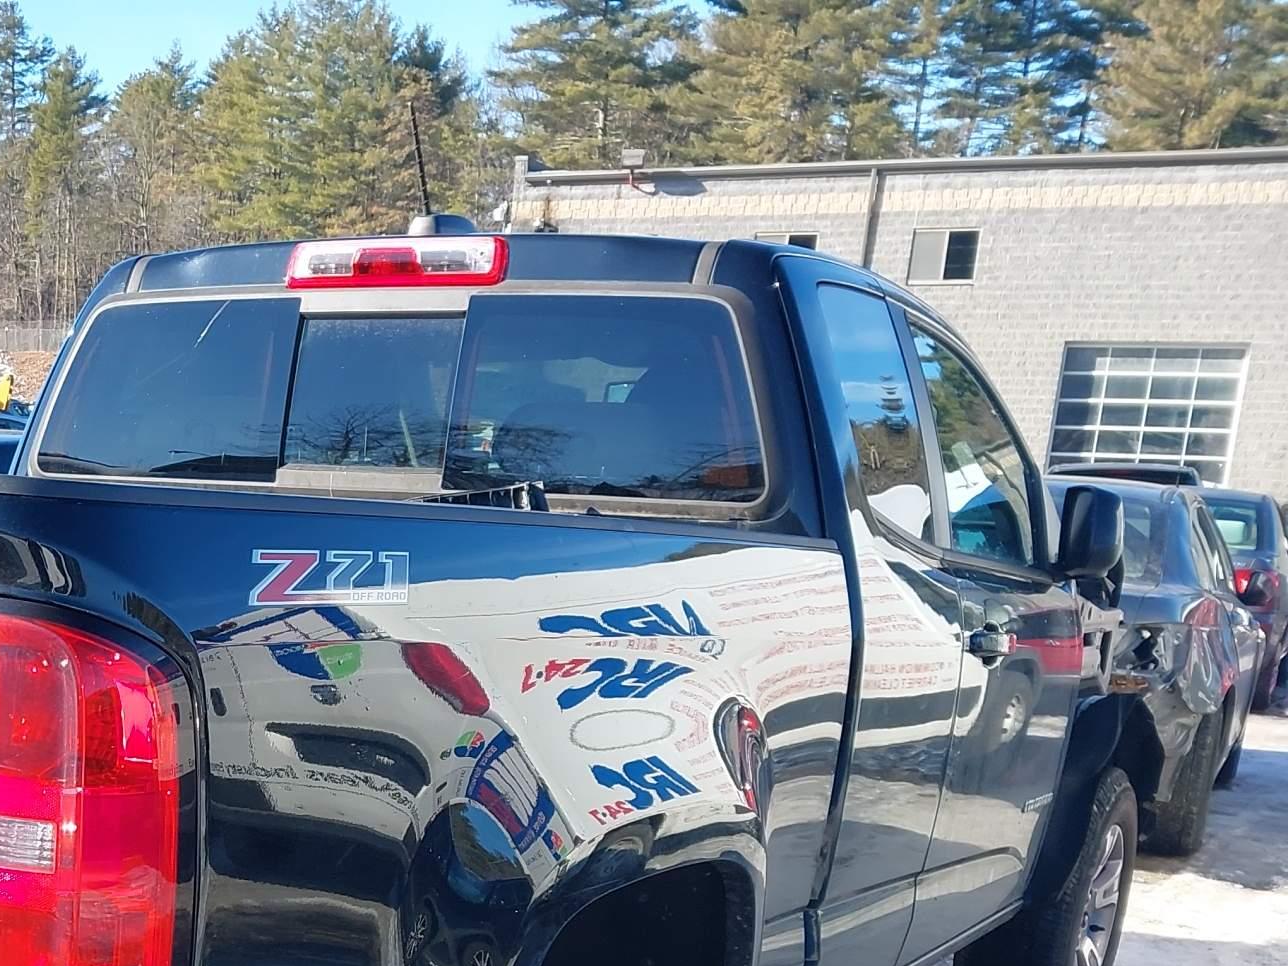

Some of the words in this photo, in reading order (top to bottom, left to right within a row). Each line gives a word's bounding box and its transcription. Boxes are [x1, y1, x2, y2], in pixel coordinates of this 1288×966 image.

[248, 549, 409, 606] Z71
[352, 591, 374, 600] OFF
[376, 591, 406, 600] ROAD
